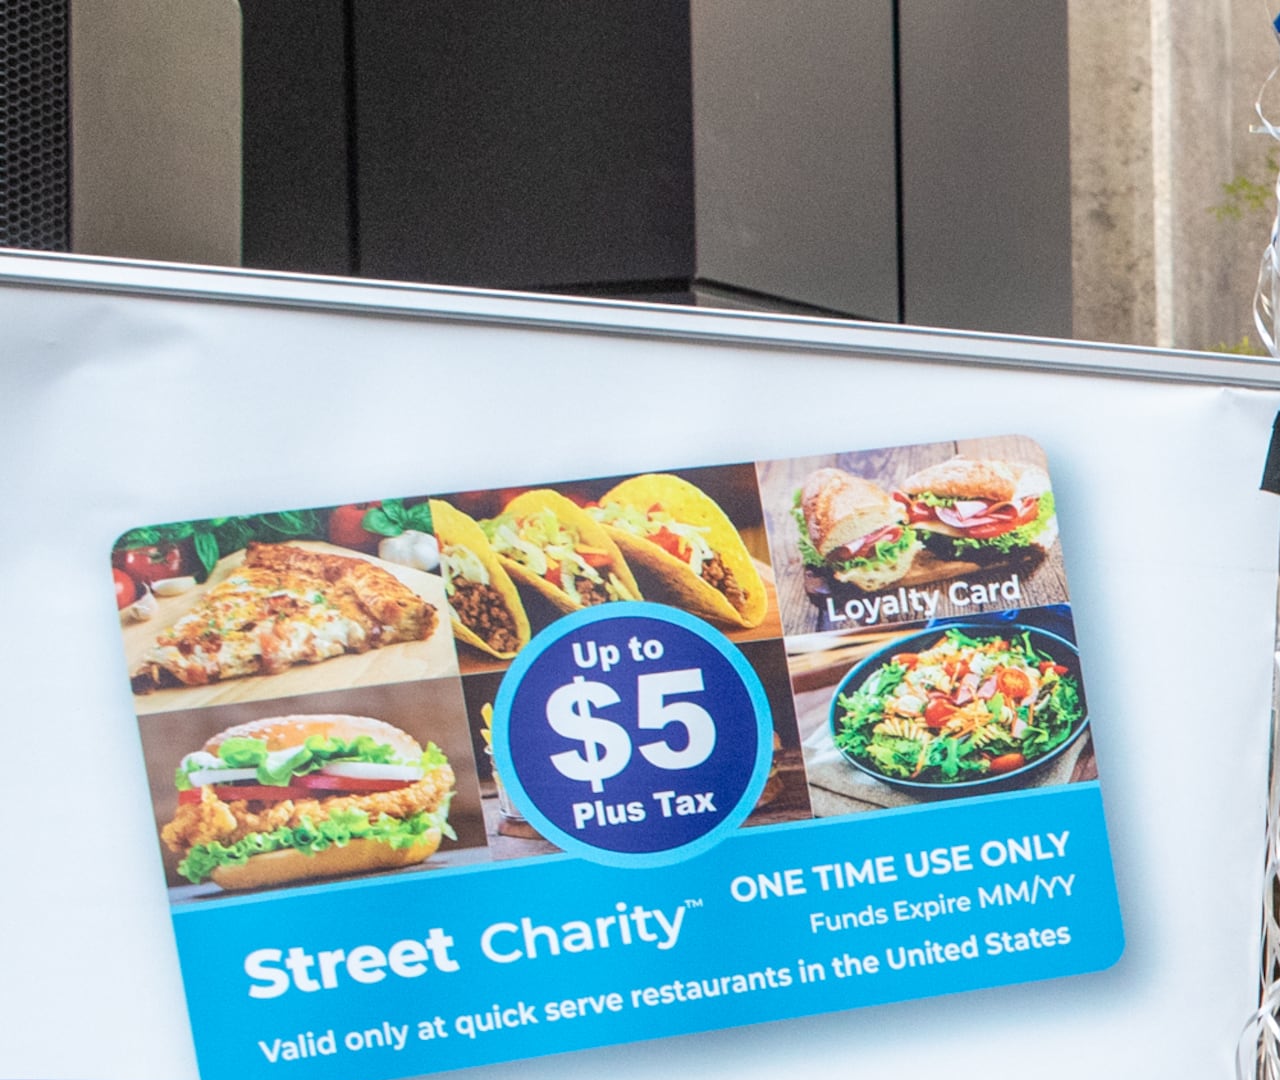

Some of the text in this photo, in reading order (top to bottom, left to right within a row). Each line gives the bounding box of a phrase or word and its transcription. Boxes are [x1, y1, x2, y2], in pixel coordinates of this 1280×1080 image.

[826, 574, 1024, 624] Loyalty Card
[572, 637, 664, 671] Up to
[545, 668, 717, 793] $5
[572, 790, 717, 829] Plus Tax
[730, 831, 1070, 902] ONE TIME USE ONLY
[810, 874, 1076, 932] Funds Expire MM/YY
[243, 928, 460, 999] Street
[258, 925, 1071, 1063] Valid only at quick serve restaurants in the United States
